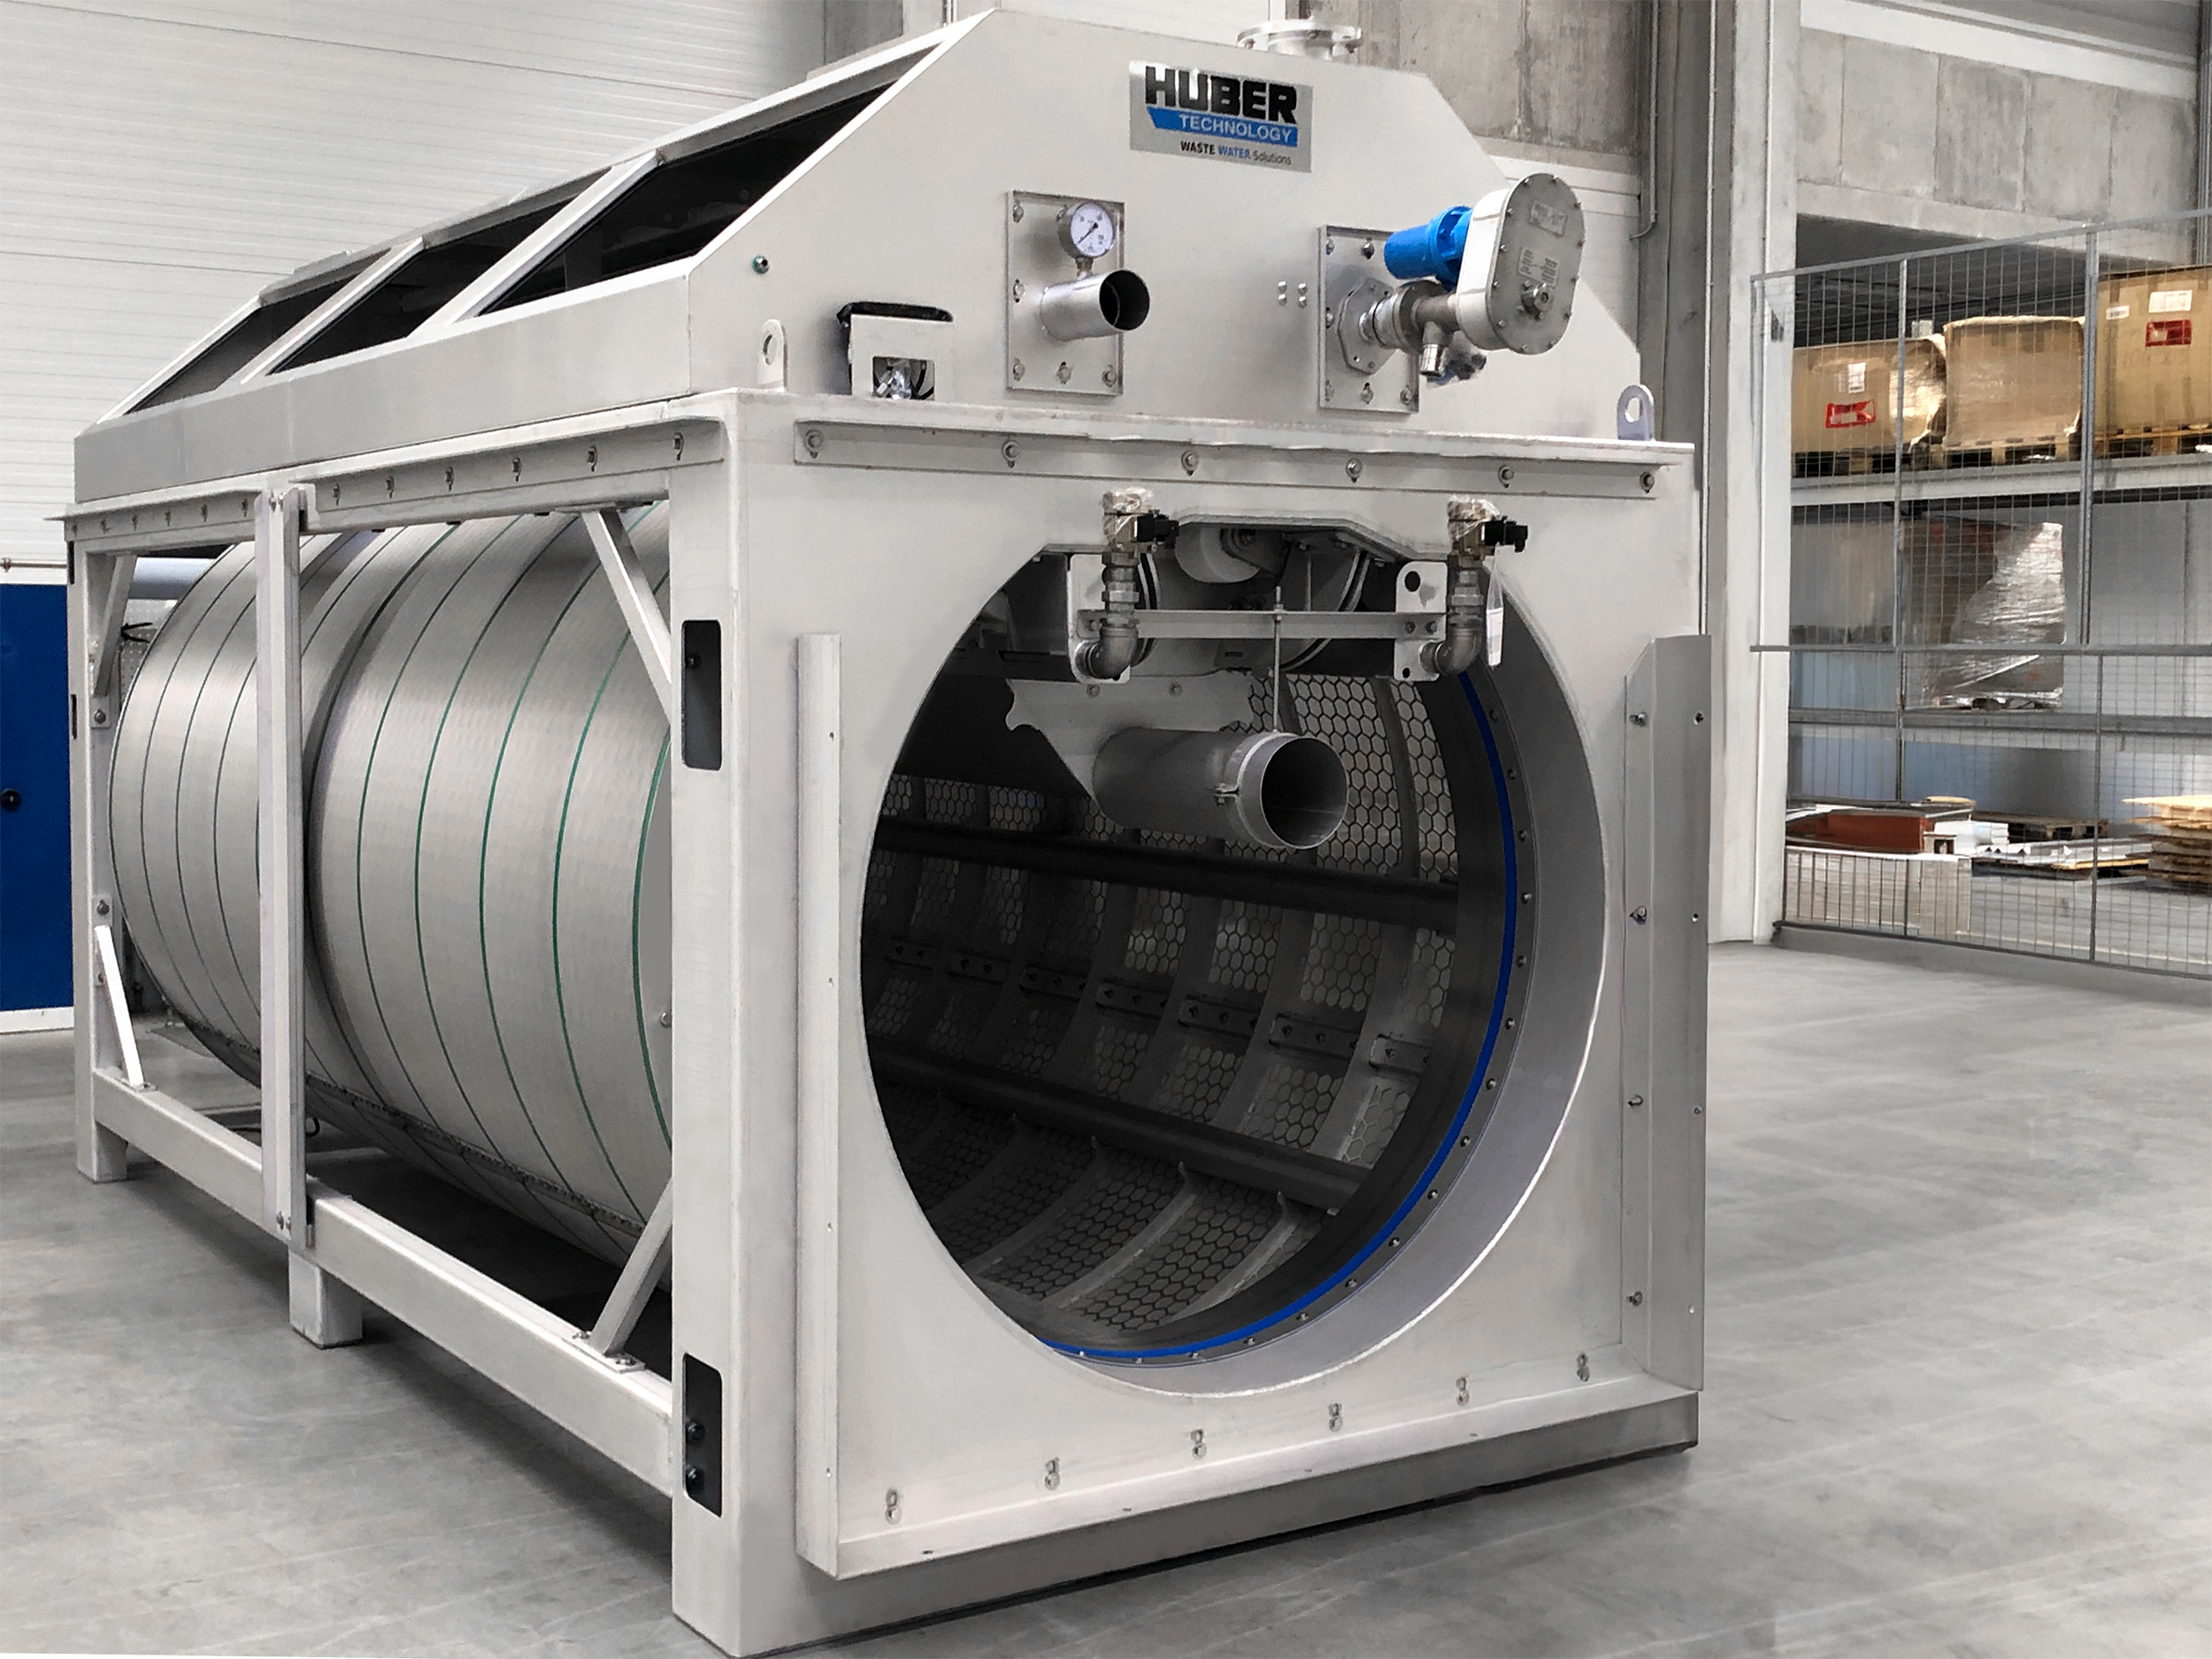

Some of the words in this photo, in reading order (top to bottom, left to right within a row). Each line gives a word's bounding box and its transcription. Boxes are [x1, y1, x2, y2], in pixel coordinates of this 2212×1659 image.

[1145, 65, 1297, 124] HUBER
[1179, 114, 1293, 142] TECHNOLOGY
[1180, 141, 1216, 155] WASTE
[1217, 145, 1250, 159] WATER
[1254, 150, 1292, 165] Solutions
